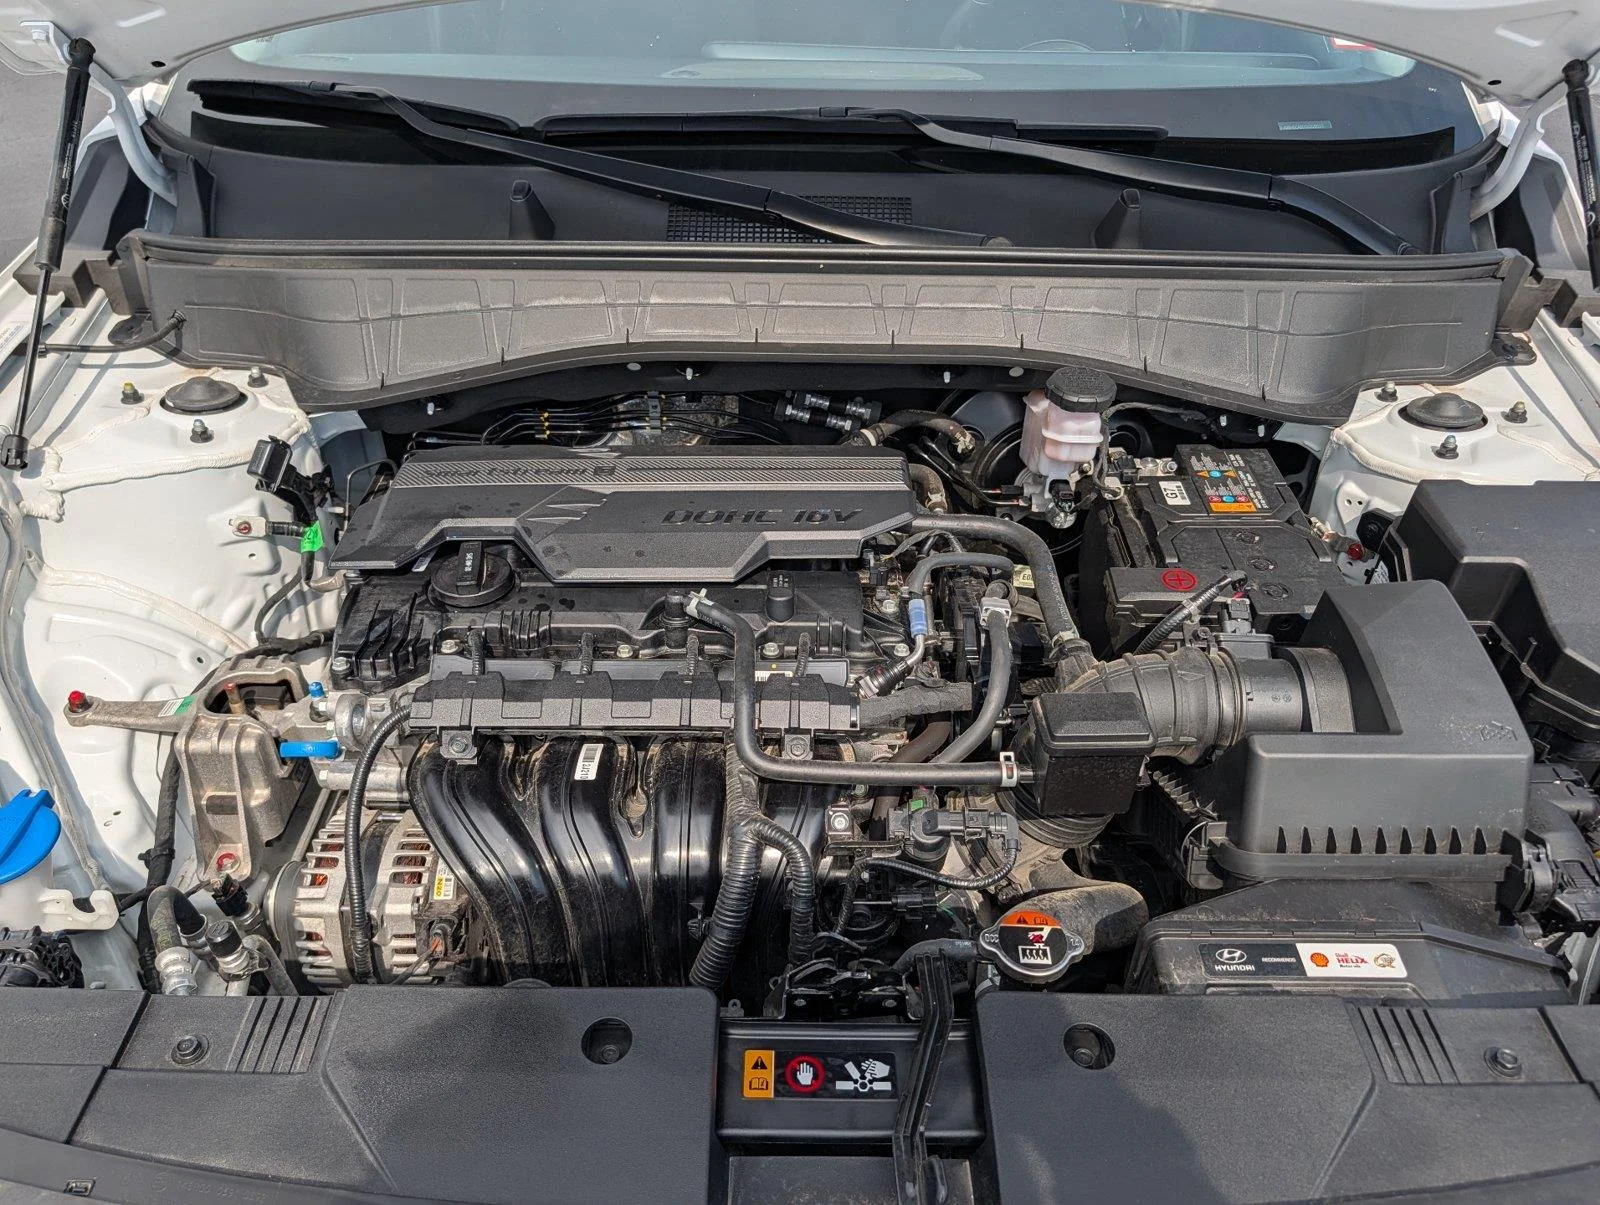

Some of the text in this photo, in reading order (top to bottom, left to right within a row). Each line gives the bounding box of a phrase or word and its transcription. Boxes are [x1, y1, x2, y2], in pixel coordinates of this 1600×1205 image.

[1163, 487, 1178, 499] G7
[661, 509, 864, 525] DOHC 16V
[1336, 955, 1369, 964] HELIX
[1214, 963, 1256, 972] HYUNDAI
